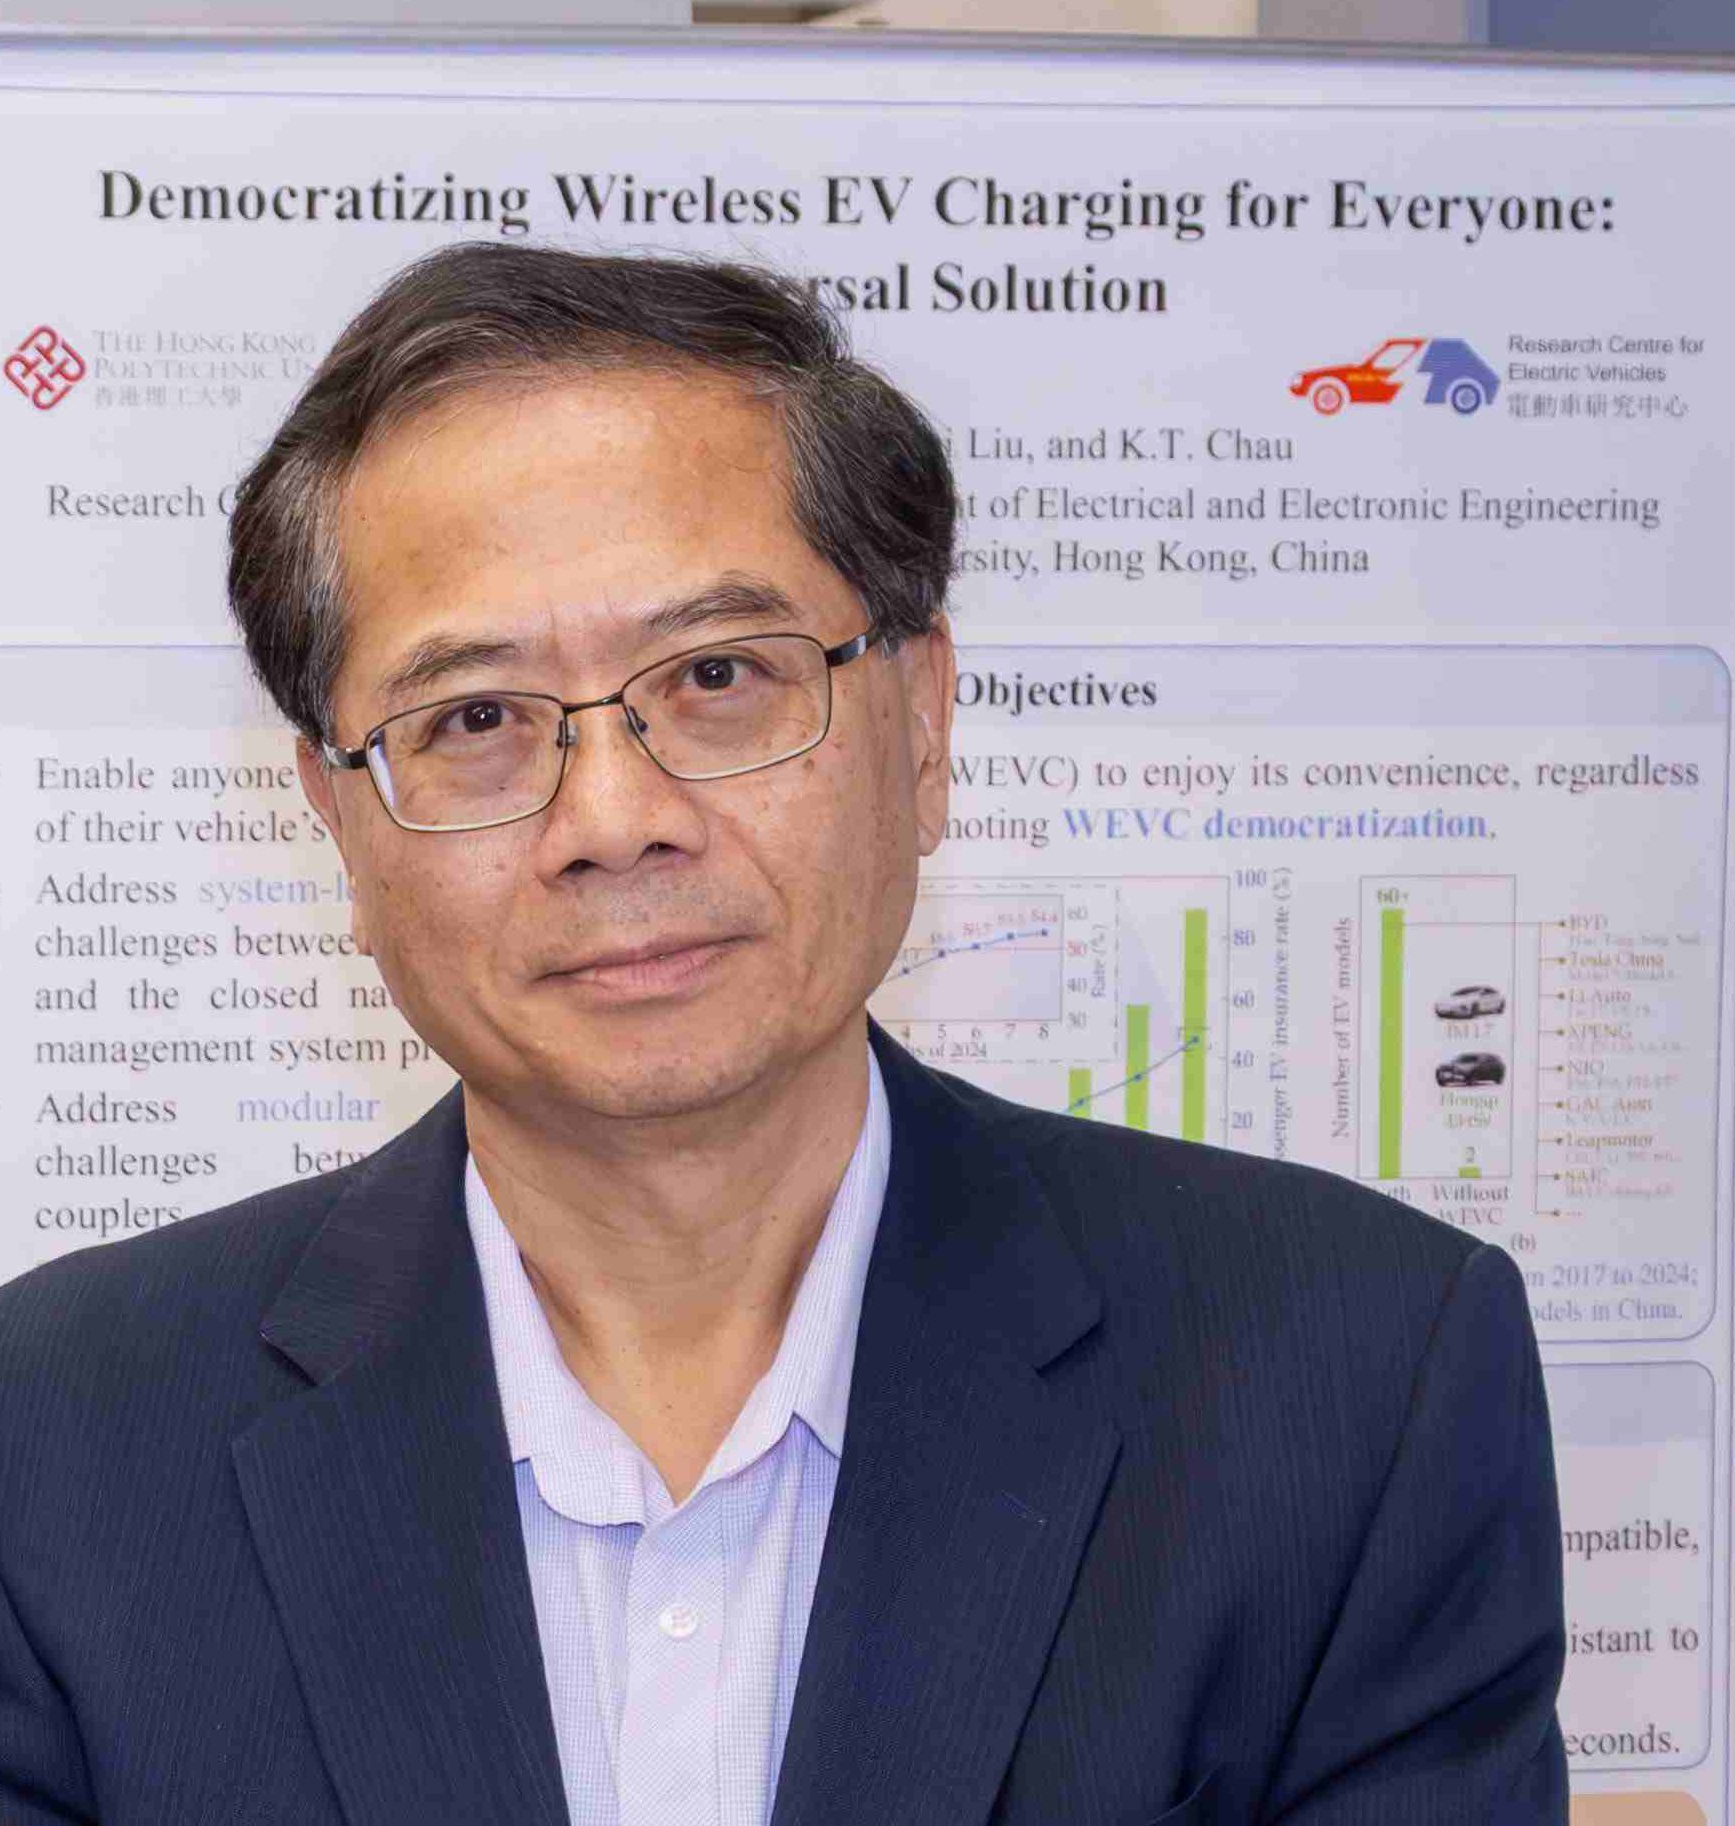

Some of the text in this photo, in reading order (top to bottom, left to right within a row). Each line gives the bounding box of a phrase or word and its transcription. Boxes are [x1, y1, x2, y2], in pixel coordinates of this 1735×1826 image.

[102, 171, 1612, 243] Democratizing Wireless EV Charging for Everyone:
[933, 265, 1166, 312] Solution
[970, 428, 1293, 464] Liu, and K.T. Chau
[1054, 540, 1369, 581] Hong Kong, China
[38, 758, 296, 799] Enable anyone
[1095, 754, 1699, 796] to enjoy its convenience, regardless
[1063, 808, 1496, 840] WEVC democratization.
